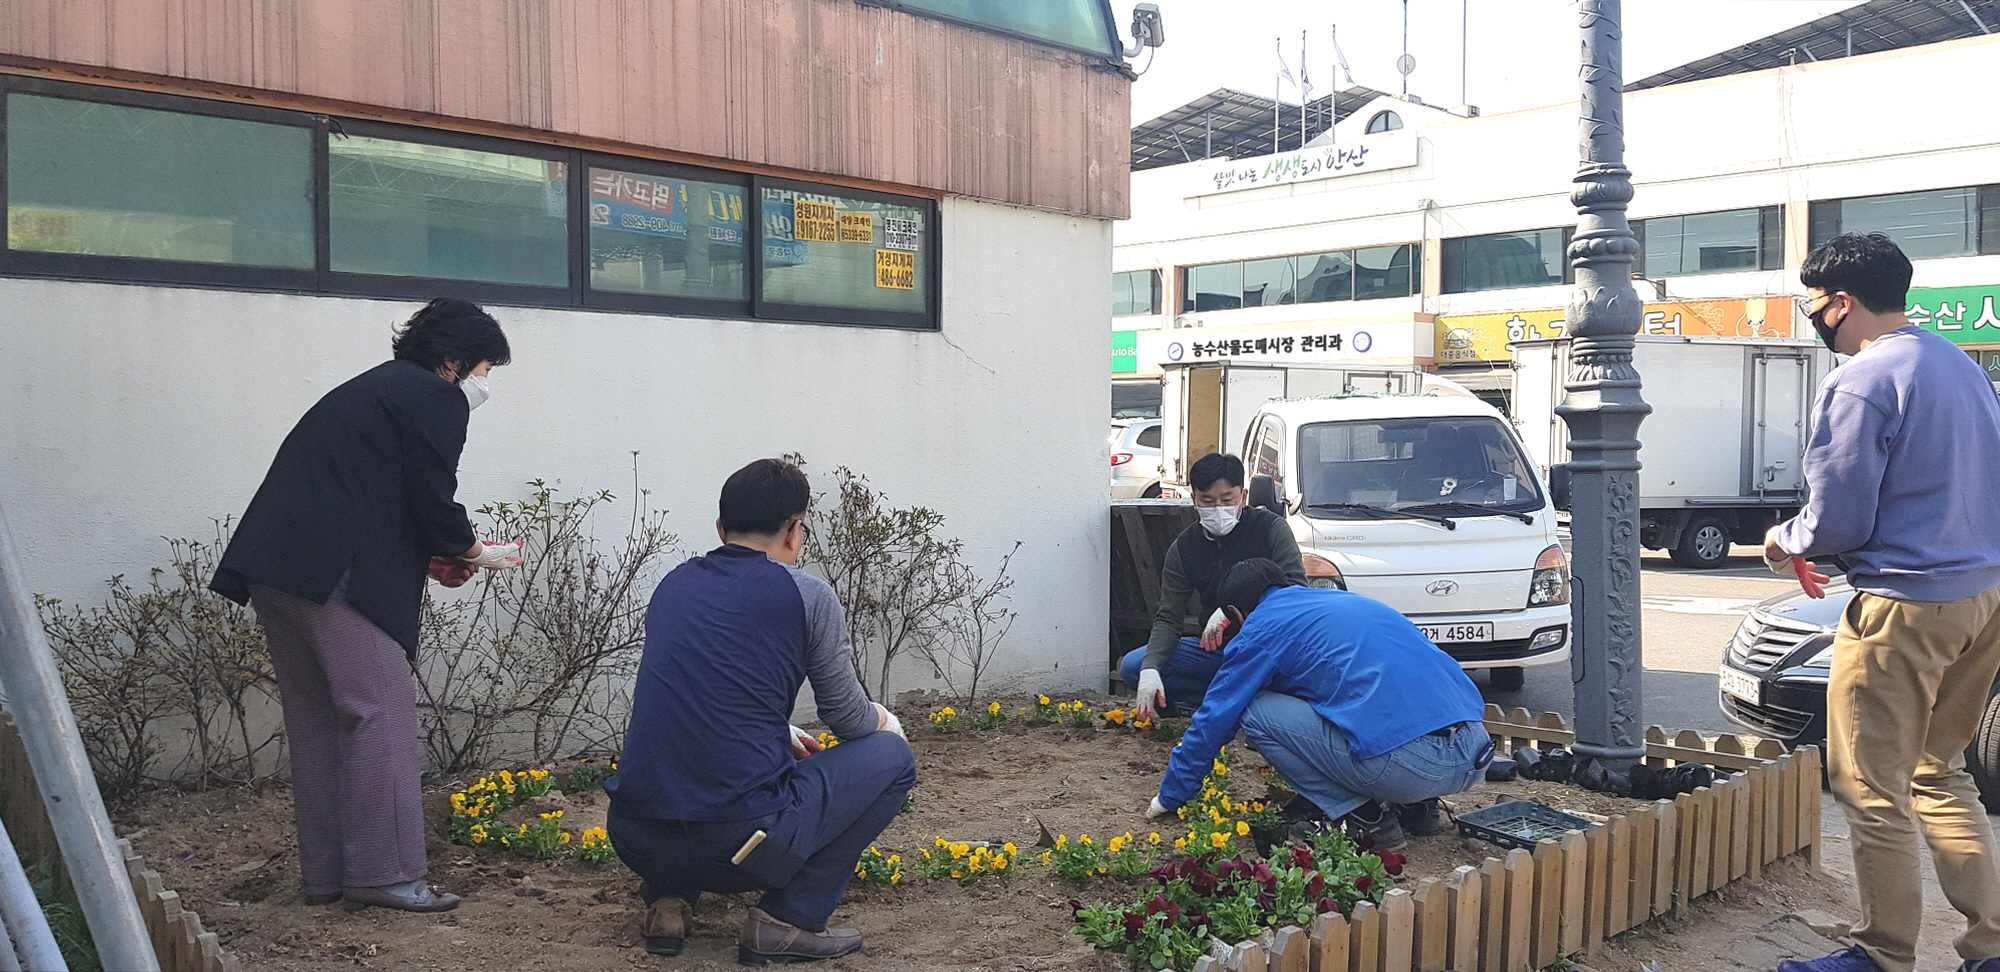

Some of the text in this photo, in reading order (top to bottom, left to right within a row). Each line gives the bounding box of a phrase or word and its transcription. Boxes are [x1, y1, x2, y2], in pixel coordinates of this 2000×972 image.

[1326, 145, 1369, 170] 안산
[796, 202, 835, 222] 성원지게차
[877, 251, 913, 269] 거성지게차
[1192, 337, 1294, 358] 농수산물도매시장
[1300, 334, 1343, 352] 관리과
[1441, 350, 1476, 359] 대중음식점
[1446, 625, 1485, 641] 4584
